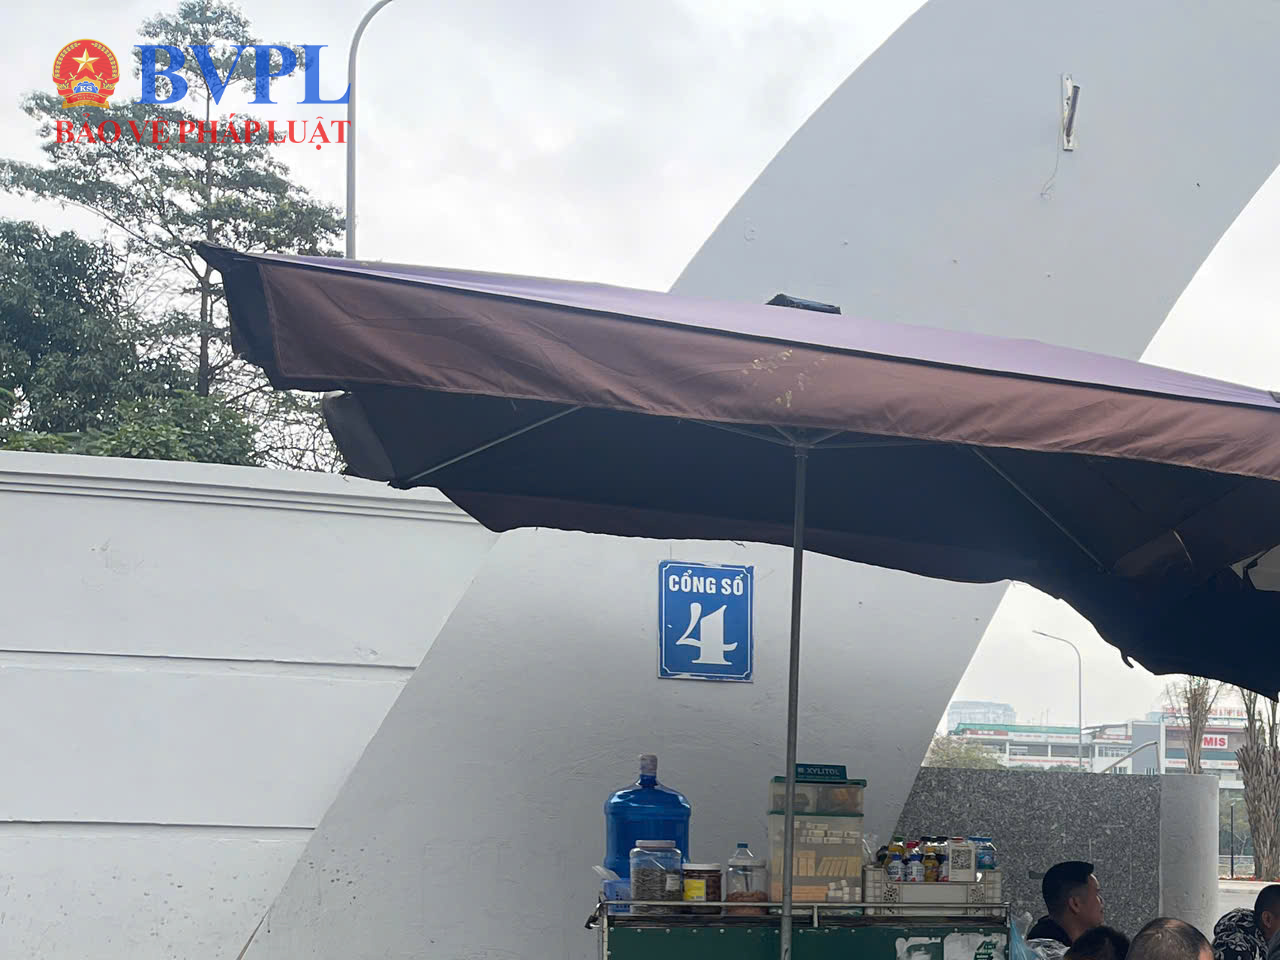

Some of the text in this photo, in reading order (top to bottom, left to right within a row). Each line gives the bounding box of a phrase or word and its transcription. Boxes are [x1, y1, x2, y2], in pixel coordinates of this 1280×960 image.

[668, 569, 744, 596] CỔNG SỐ
[675, 602, 738, 665] 4
